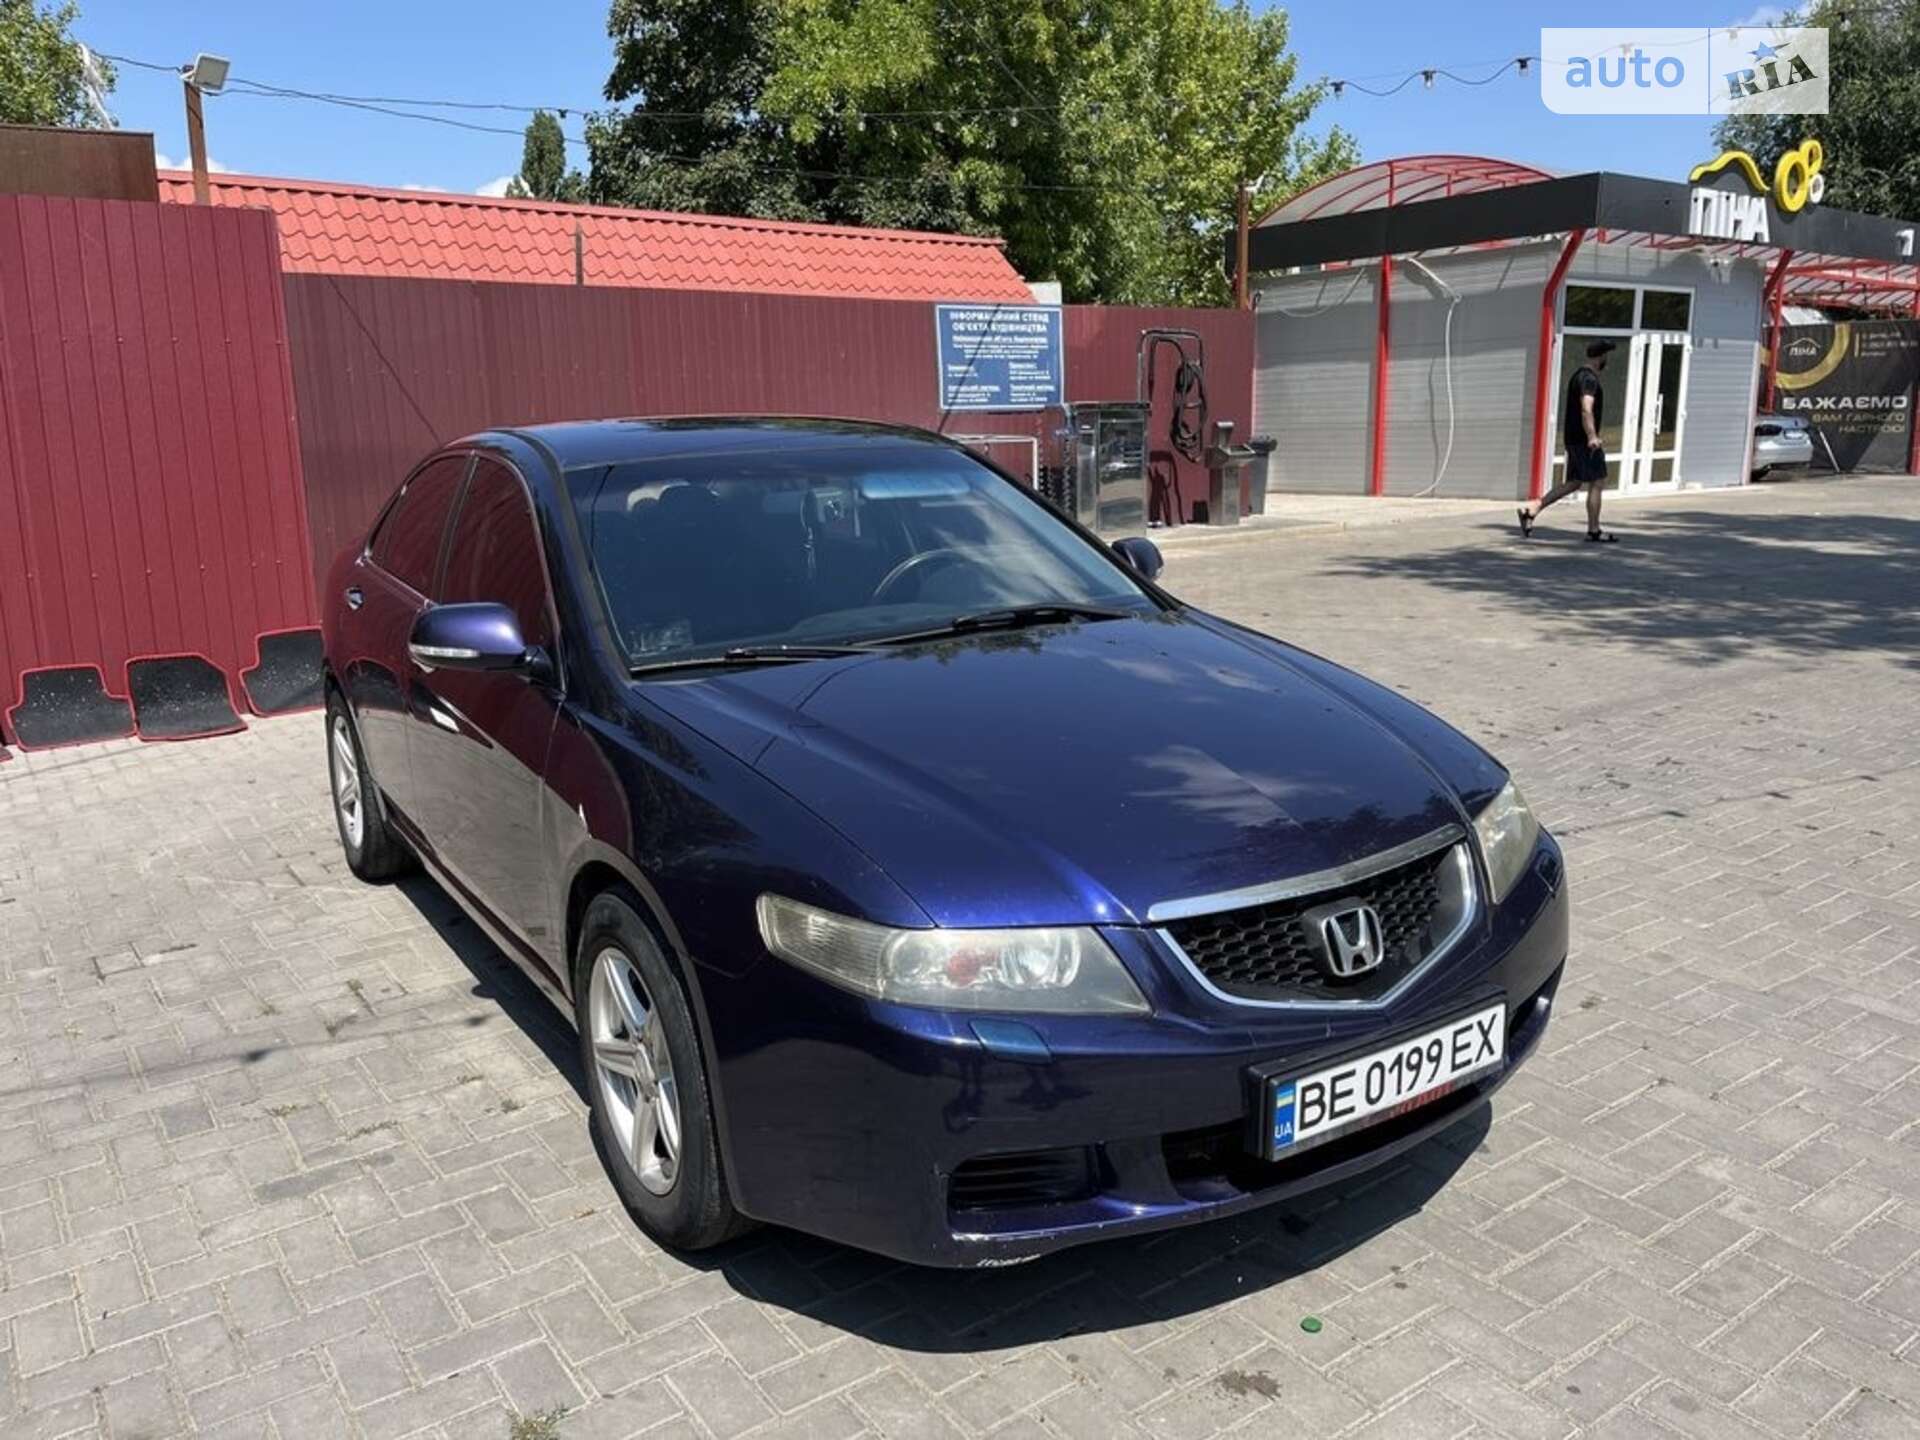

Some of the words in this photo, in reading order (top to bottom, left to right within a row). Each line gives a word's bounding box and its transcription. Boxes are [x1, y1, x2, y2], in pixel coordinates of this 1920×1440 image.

[1689, 187, 1770, 244] ПІНА
[1782, 396, 1908, 410] БАЖАЄМО
[1299, 1069, 1356, 1132] BE
[1365, 1038, 1443, 1106] 0199
[1451, 1013, 1497, 1073] EX
[1274, 1122, 1293, 1138] UA
